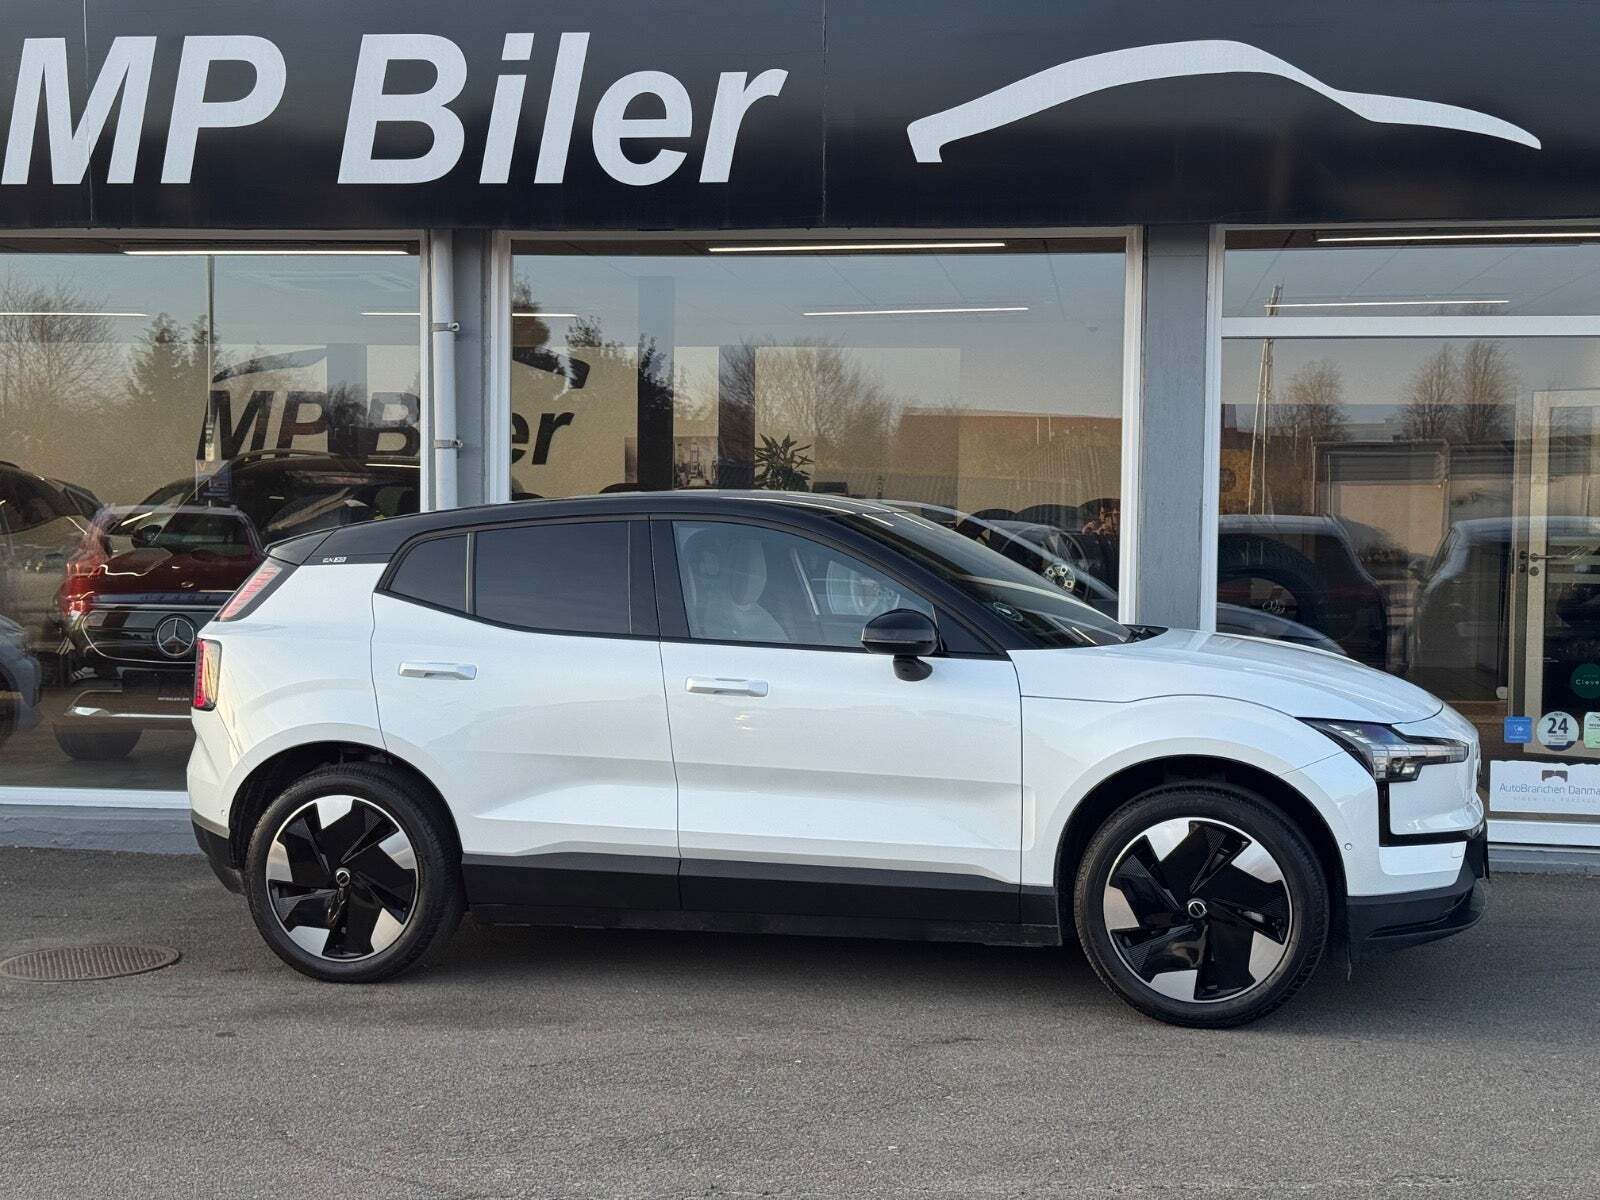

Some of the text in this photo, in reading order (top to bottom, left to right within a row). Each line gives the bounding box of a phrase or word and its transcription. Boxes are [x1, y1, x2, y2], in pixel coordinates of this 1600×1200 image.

[1, 32, 790, 187] MP Biler
[1547, 717, 1569, 735] 24
